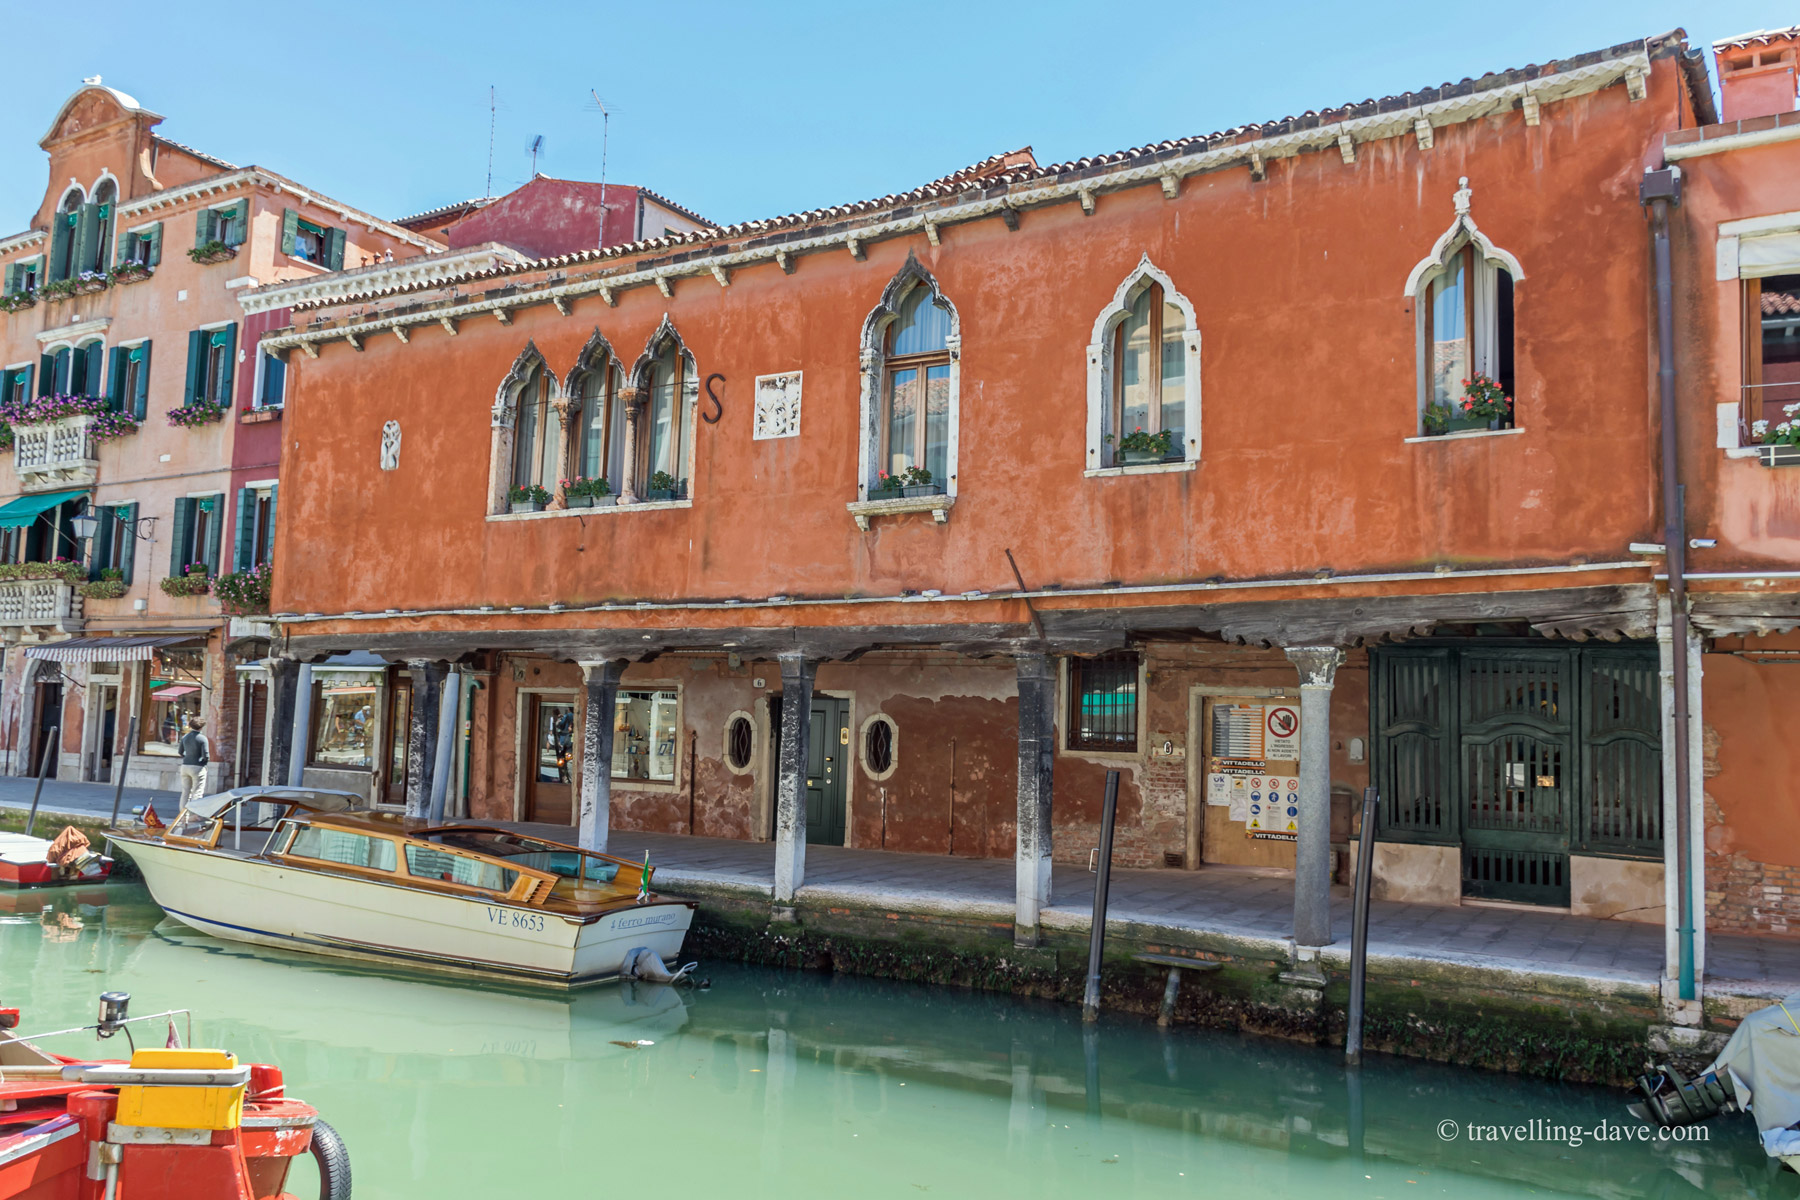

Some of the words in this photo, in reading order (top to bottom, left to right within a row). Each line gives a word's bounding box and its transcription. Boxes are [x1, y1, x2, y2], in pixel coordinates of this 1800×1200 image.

[487, 907, 508, 925] VE
[512, 911, 544, 932] 8653
[618, 917, 643, 928] ferro
[645, 912, 676, 925] murano
